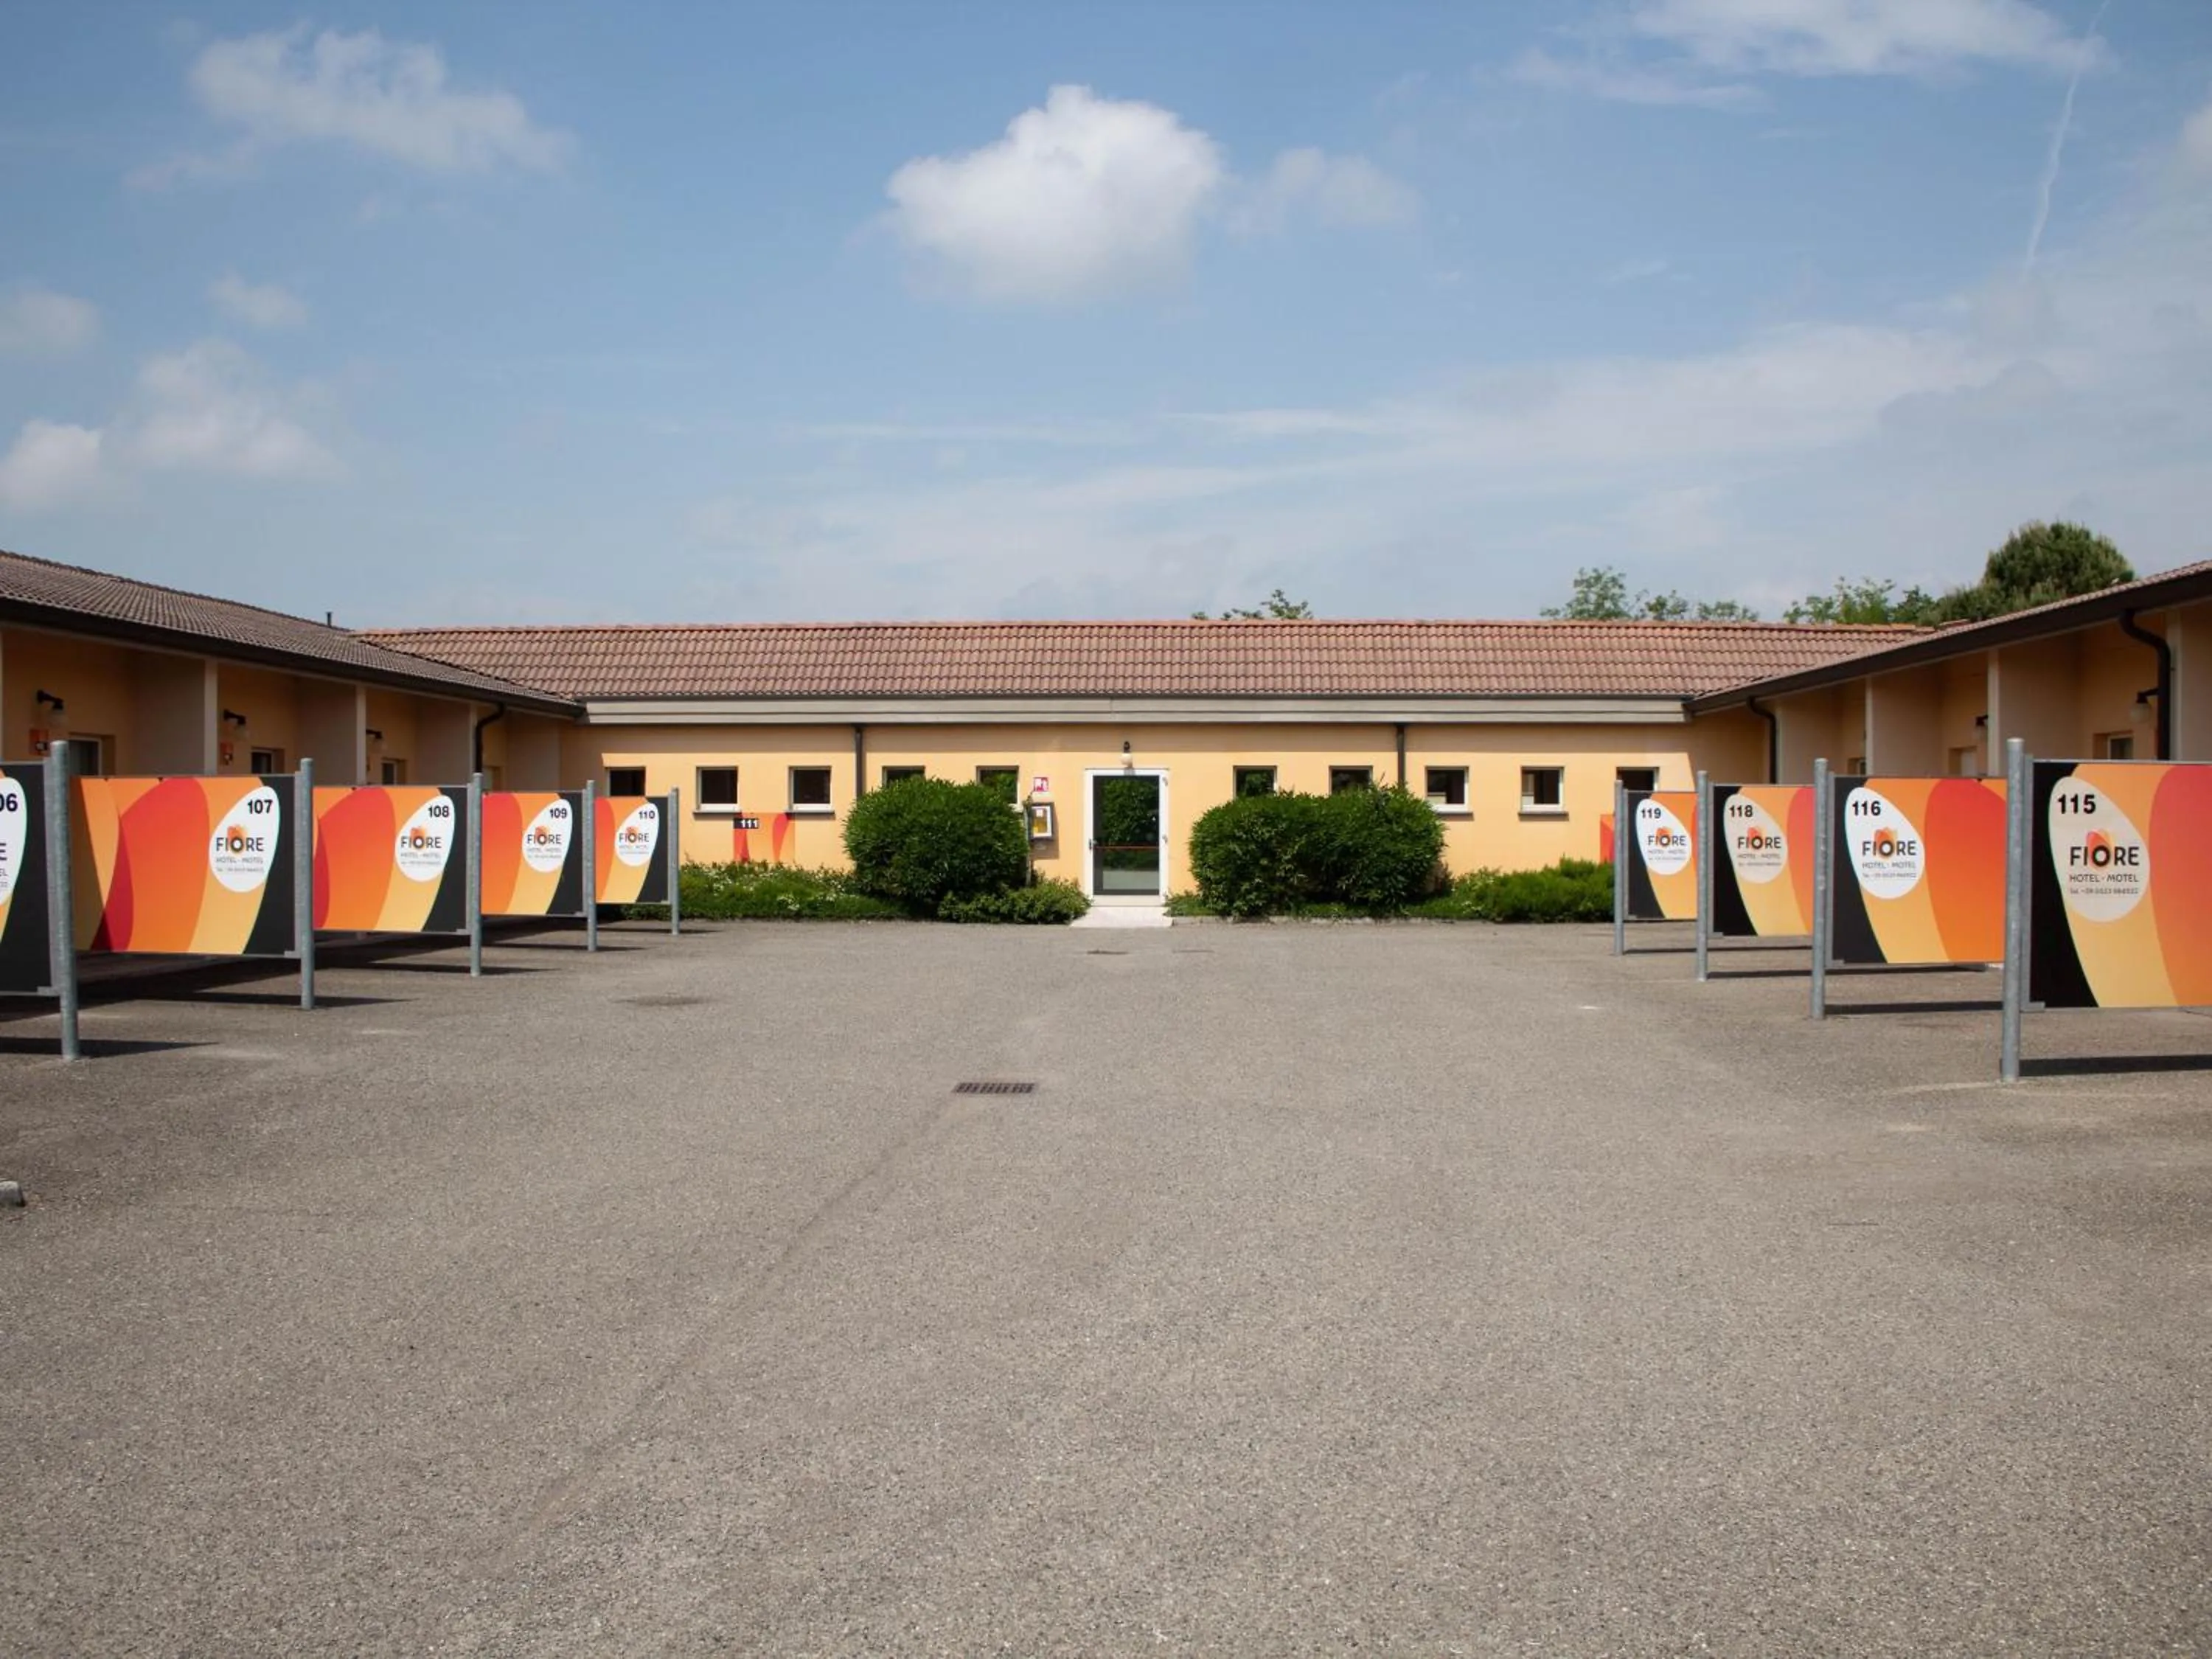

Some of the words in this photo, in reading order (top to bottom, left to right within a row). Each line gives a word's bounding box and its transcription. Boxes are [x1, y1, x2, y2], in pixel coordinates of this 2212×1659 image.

[247, 799, 273, 814] 107
[1852, 801, 1881, 816] 116
[2058, 793, 2096, 814] 115
[428, 805, 449, 818] 108
[550, 808, 567, 818] 109
[639, 810, 655, 820] 110
[1641, 808, 1661, 818] 119
[1730, 805, 1753, 818] 118
[741, 819, 757, 827] 111
[401, 836, 442, 849] FIORE
[527, 834, 561, 845] FIORE
[619, 832, 650, 843] FIORE
[1647, 835, 1686, 846] FIORE
[1737, 836, 1781, 849] FIORE
[216, 837, 264, 854] FIORE
[1863, 841, 1916, 857] FIORE
[2070, 846, 2140, 866] FIORE
[2070, 874, 2100, 883] HOTEL
[2107, 874, 2139, 883] MOTEL
